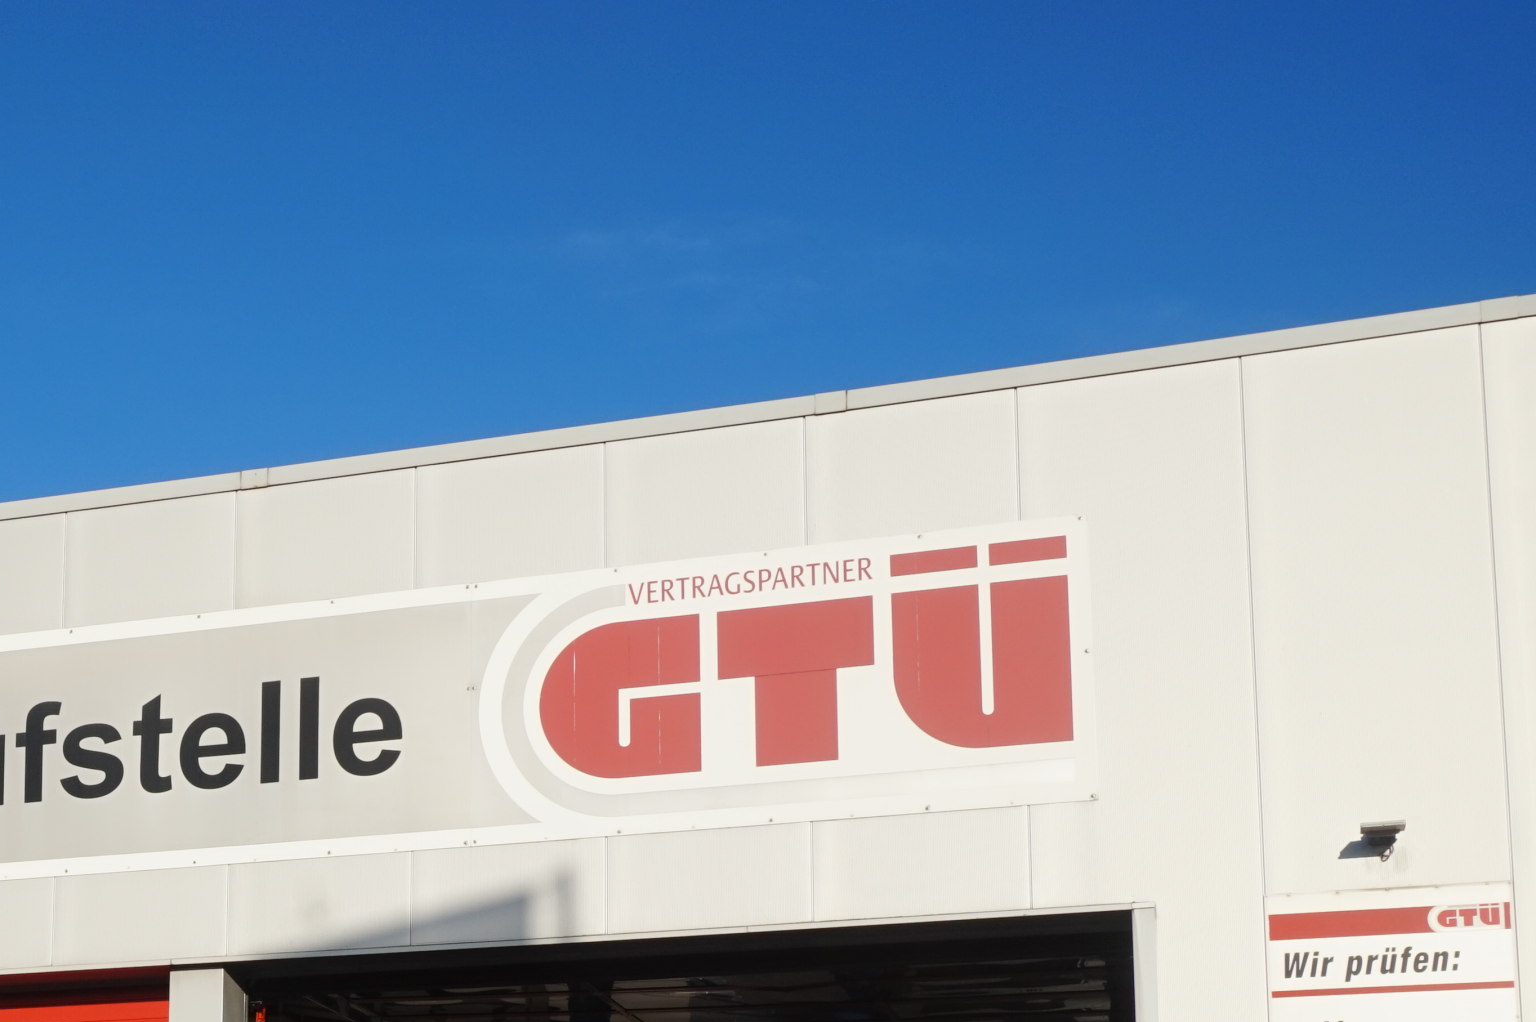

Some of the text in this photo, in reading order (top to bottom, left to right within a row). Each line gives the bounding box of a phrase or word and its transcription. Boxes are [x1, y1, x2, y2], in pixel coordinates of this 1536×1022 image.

[628, 556, 873, 606] VERTRAGSPARTNER
[539, 534, 1074, 779] GTÜ
[1437, 903, 1500, 928] GTÜ
[1284, 946, 1460, 982] Wir prüfen:
